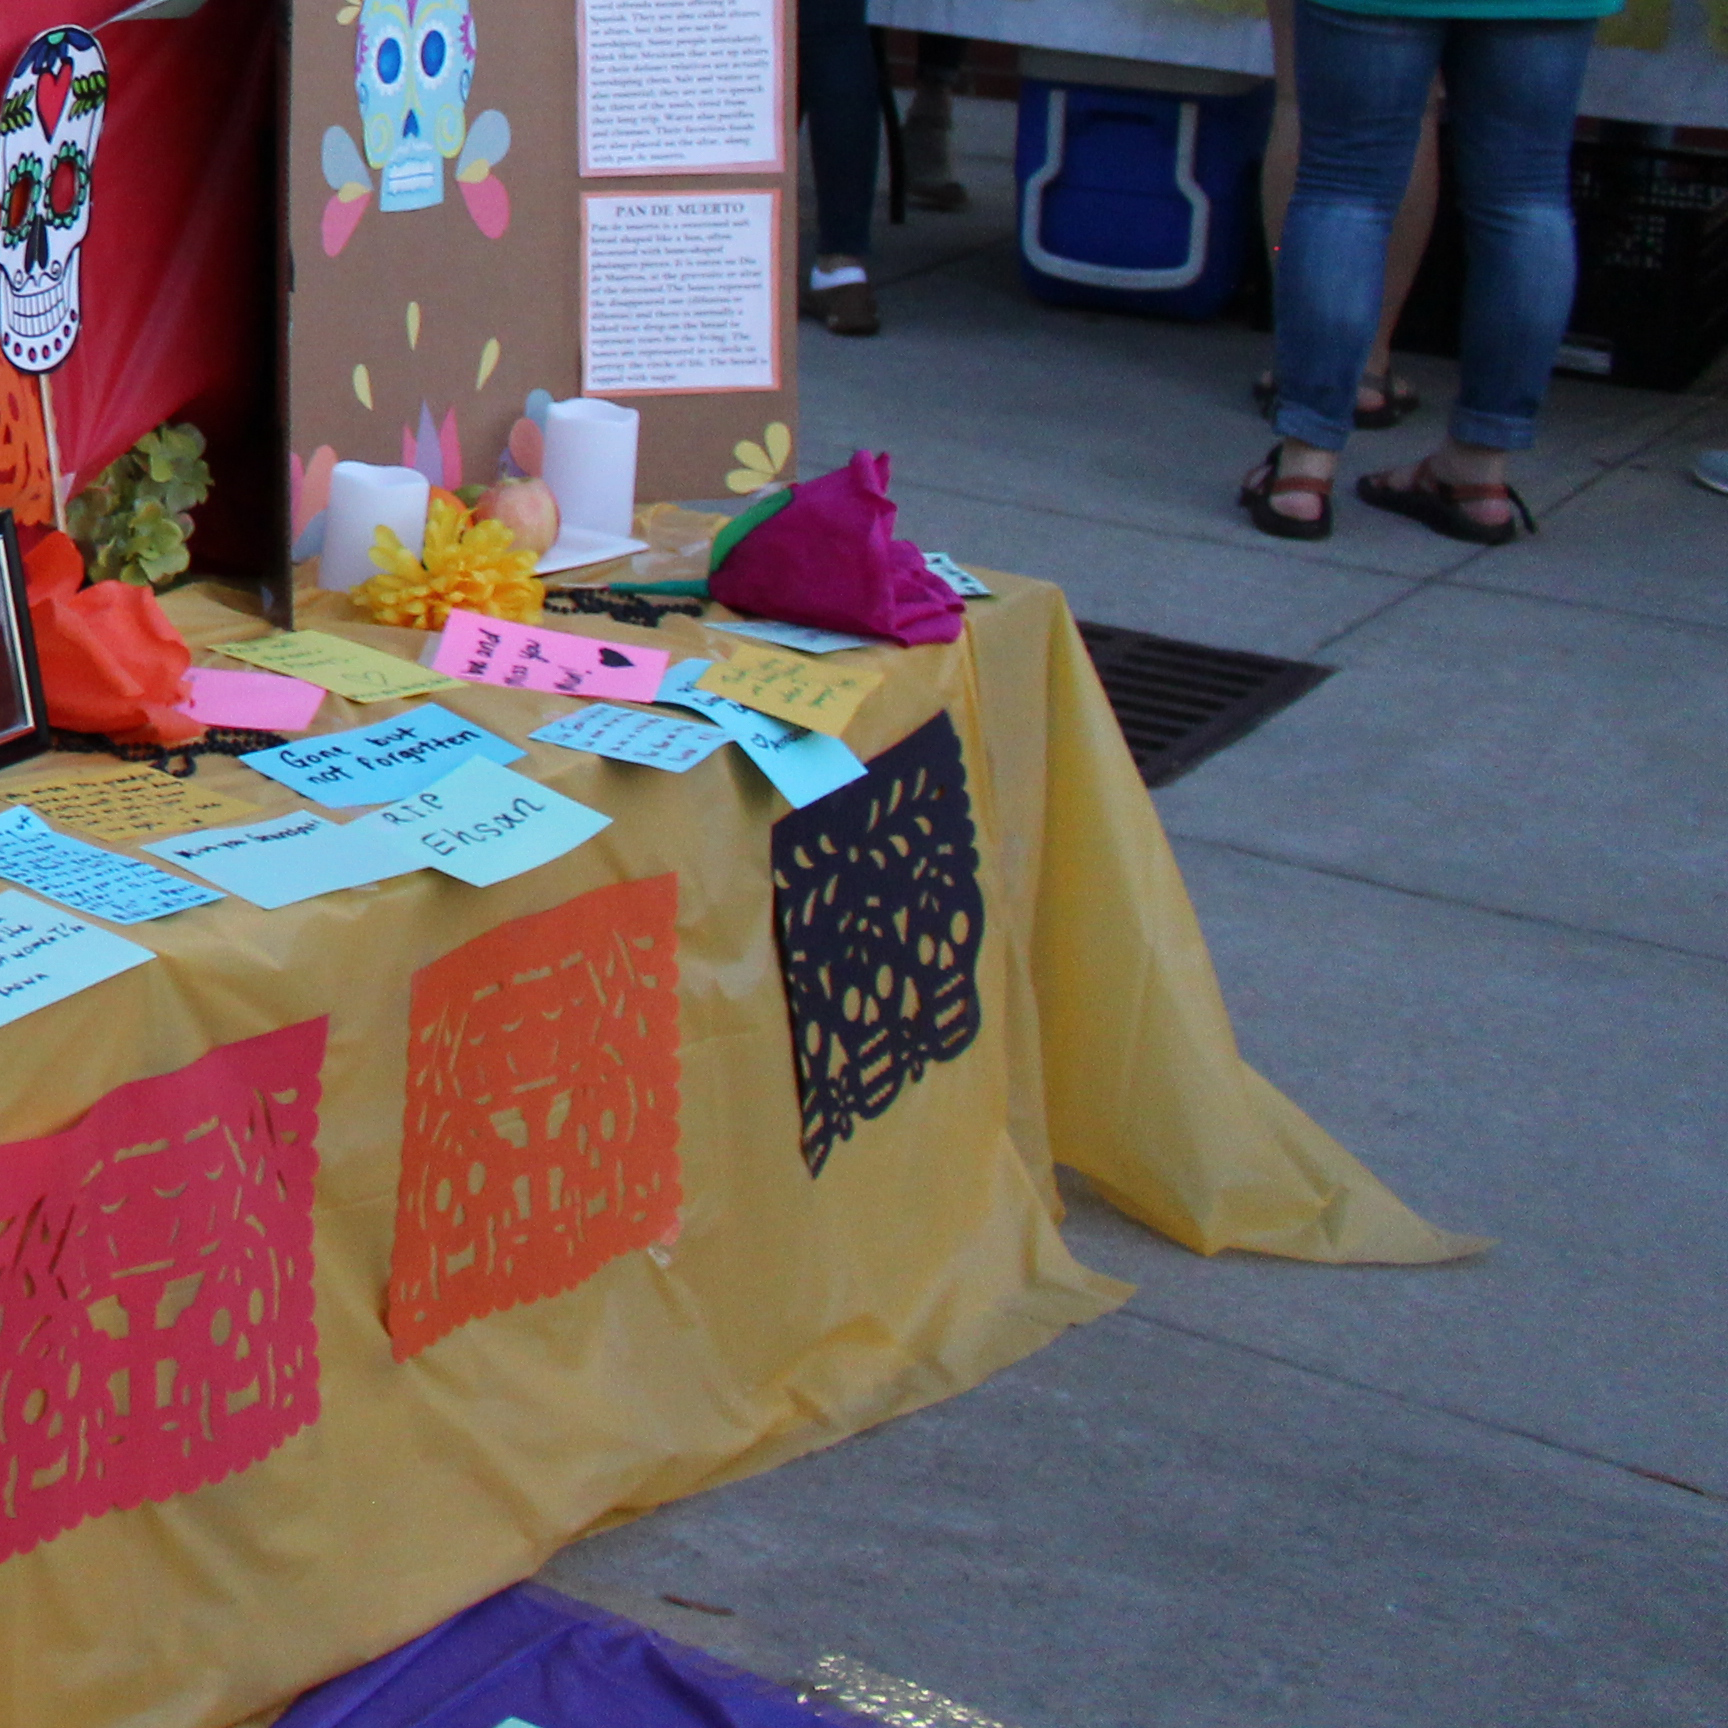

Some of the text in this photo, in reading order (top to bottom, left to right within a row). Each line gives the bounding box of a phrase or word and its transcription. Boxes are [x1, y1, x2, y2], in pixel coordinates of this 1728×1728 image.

[615, 202, 746, 218] PAN DE MUERTO
[280, 725, 419, 771] Gone but
[306, 762, 355, 786] not
[419, 793, 547, 857] Ehsan
